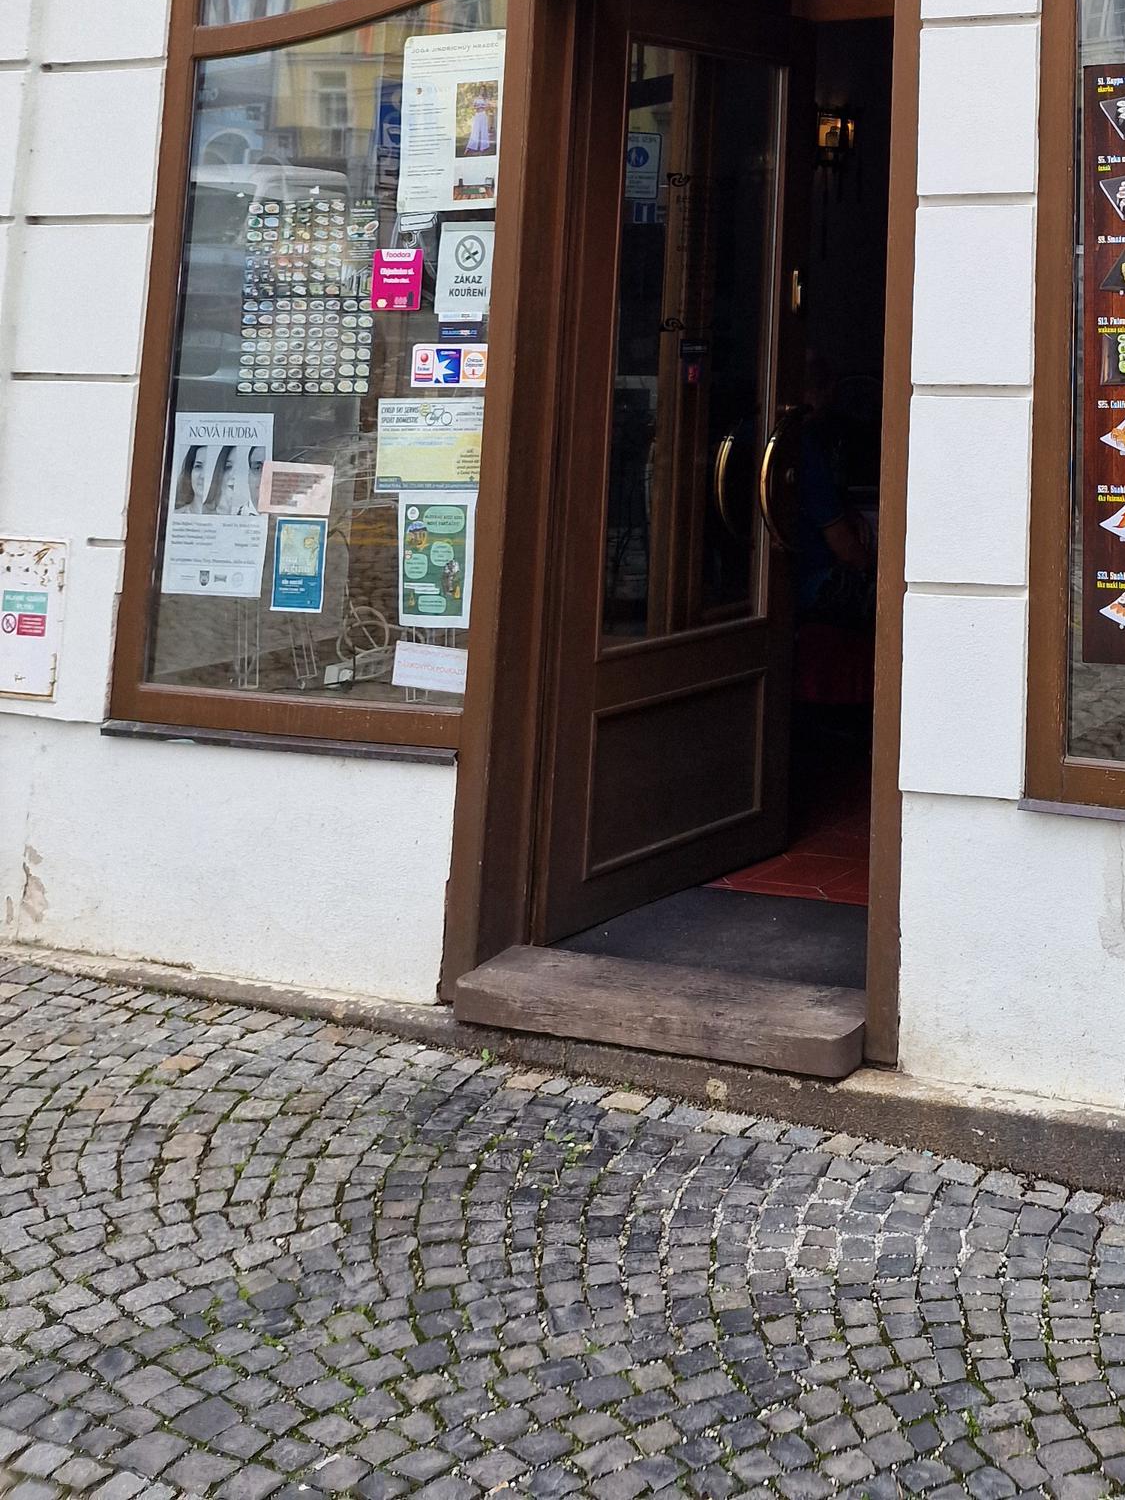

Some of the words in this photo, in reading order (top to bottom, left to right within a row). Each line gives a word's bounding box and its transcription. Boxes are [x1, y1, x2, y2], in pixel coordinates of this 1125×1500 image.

[455, 275, 482, 283] ZÁKAZ
[449, 287, 486, 297] KOUŘENÍ
[189, 424, 220, 438] NOVÁ
[222, 425, 258, 438] HUDBA
